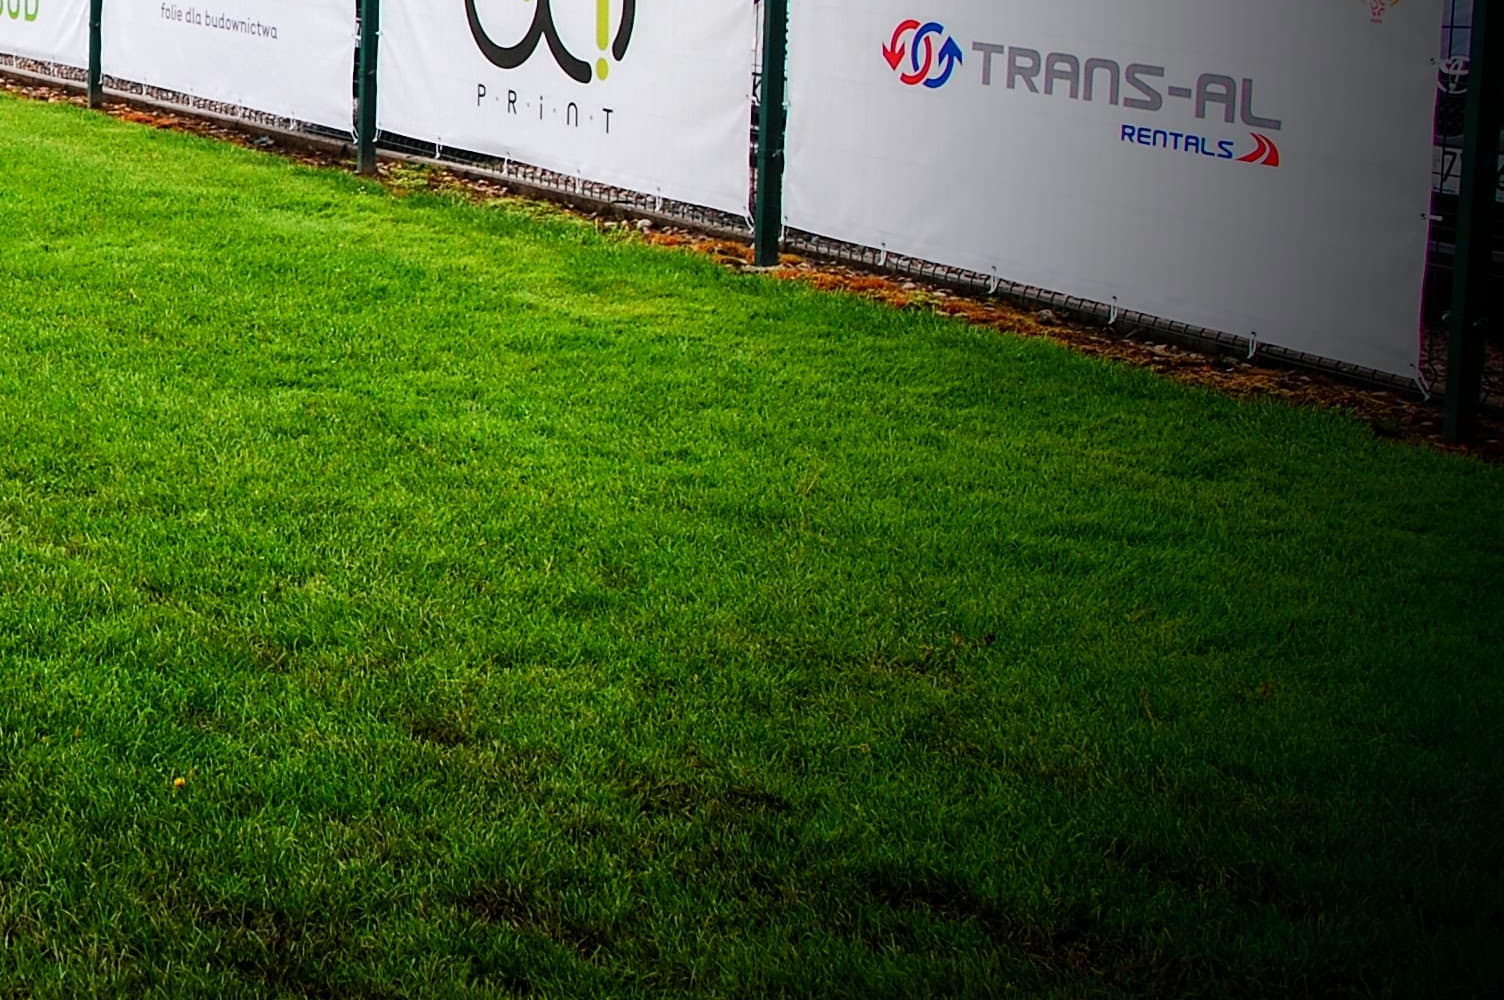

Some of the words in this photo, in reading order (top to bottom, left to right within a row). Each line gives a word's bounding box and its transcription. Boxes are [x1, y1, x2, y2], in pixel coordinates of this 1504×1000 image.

[160, 2, 183, 22] folie
[185, 7, 203, 26] dla
[204, 10, 279, 40] budownictwa
[971, 40, 1283, 131] TRANS-AL
[1120, 123, 1235, 160] RENTALS
